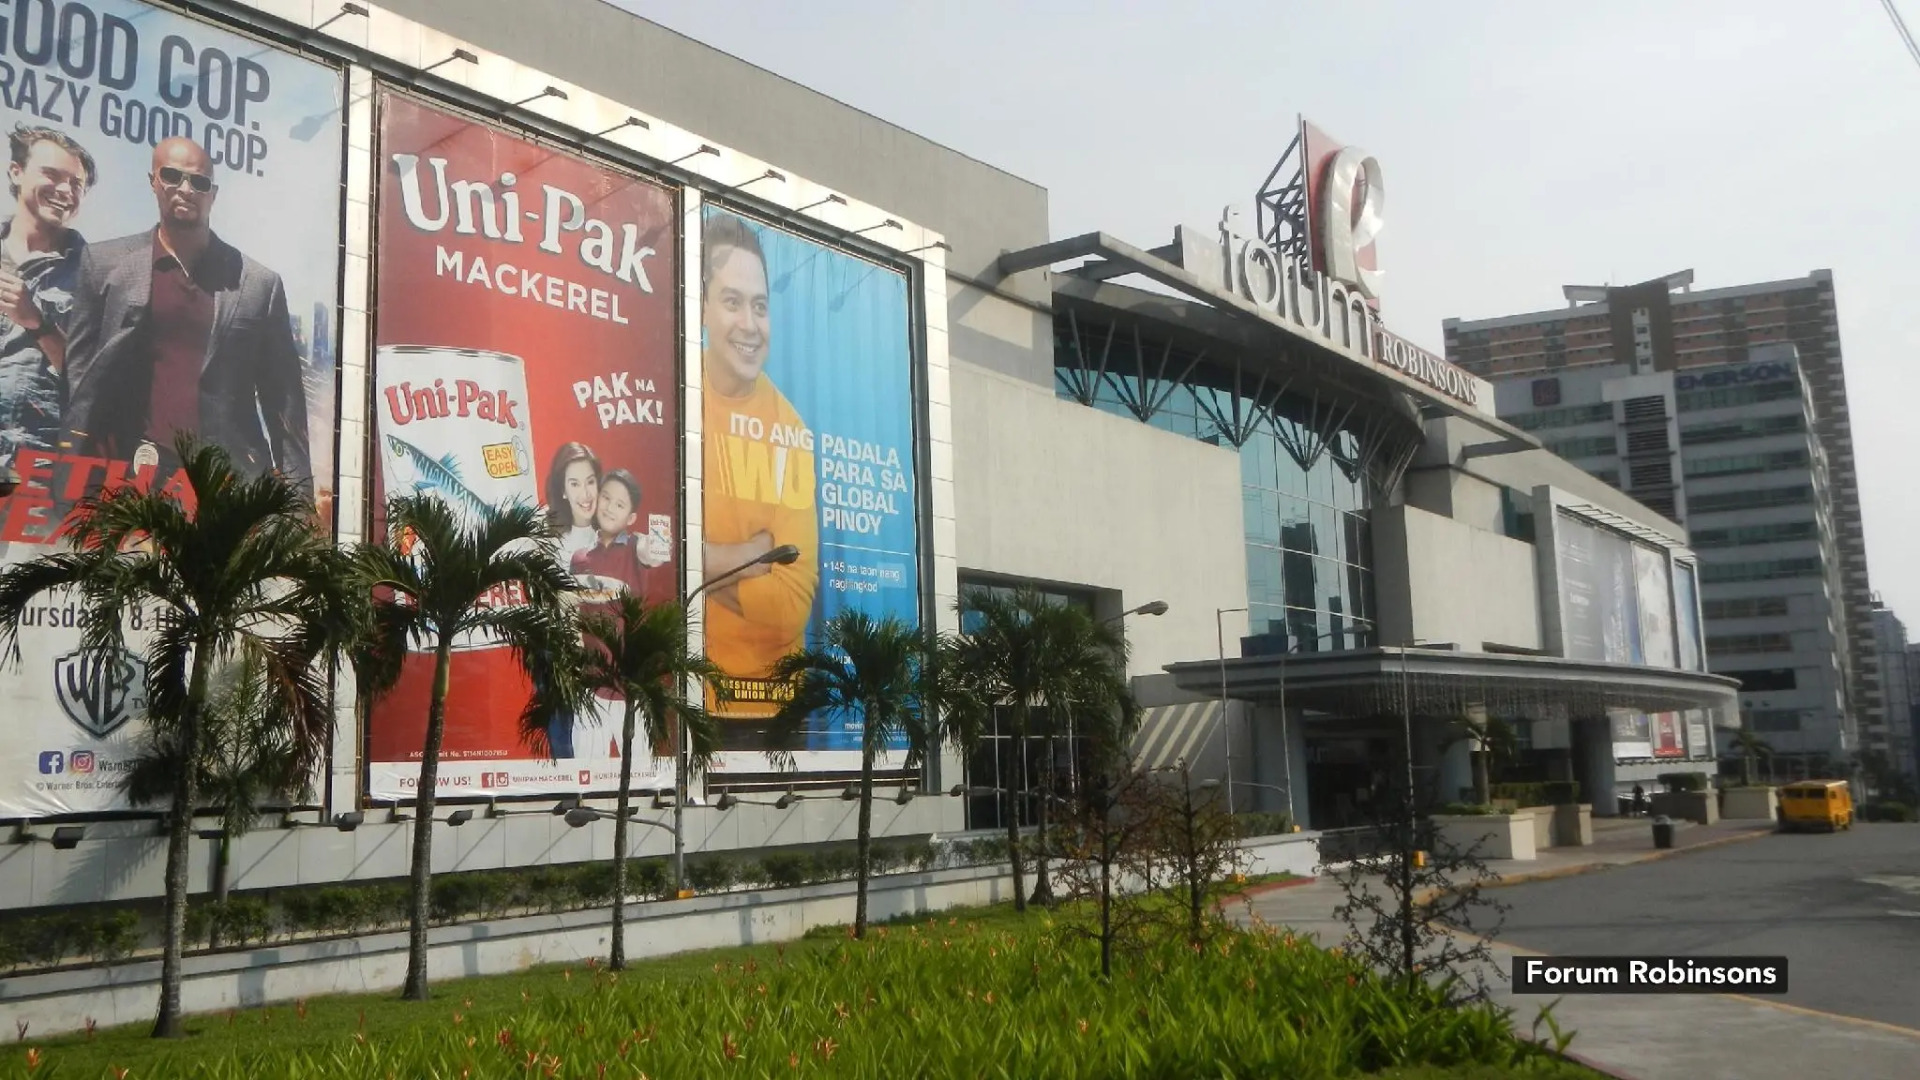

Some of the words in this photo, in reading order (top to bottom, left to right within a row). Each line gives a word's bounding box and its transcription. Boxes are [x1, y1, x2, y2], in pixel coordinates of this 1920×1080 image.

[158, 35, 270, 130] COP.
[100, 92, 192, 149] GOOD
[203, 122, 268, 177] COP.
[392, 154, 656, 293] Uni-Pak
[436, 245, 629, 324] MACKEREL
[1218, 204, 1374, 360] forum
[1379, 331, 1478, 406] ROBINSONS
[384, 378, 518, 428] Uni-Pak
[572, 371, 633, 409] PAK
[634, 379, 656, 393] NA
[597, 399, 664, 429] PAK!
[730, 412, 764, 440] ITO
[769, 422, 814, 451] ANG
[486, 447, 513, 461] EASY
[489, 459, 518, 475] OPEN
[821, 433, 902, 469] PADALA
[14, 446, 200, 525] ETHA
[726, 435, 816, 511] WU
[821, 458, 876, 487] PARA
[880, 470, 908, 492] SA
[821, 482, 900, 515] GLOBAL
[822, 507, 882, 536] PINOY
[830, 561, 845, 573] 145
[21, 602, 91, 628] ursda
[734, 690, 765, 700] UNION
[453, 775, 472, 787] US!
